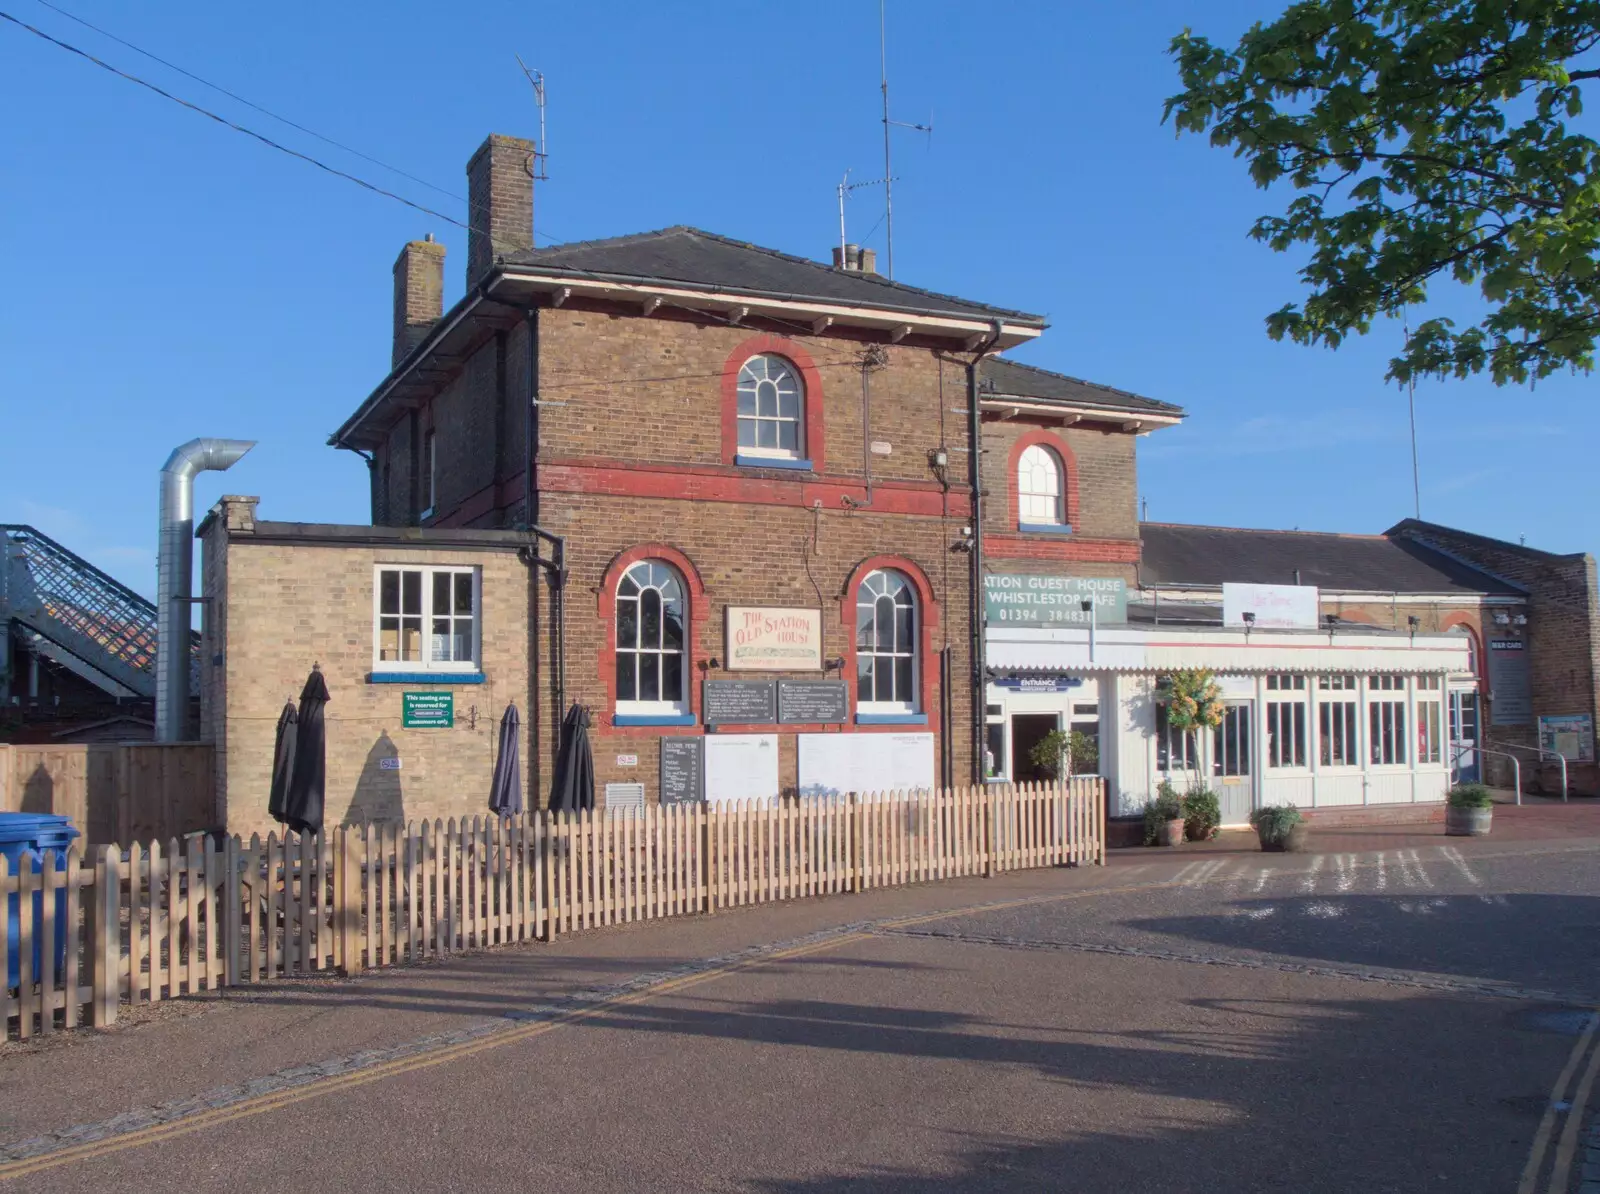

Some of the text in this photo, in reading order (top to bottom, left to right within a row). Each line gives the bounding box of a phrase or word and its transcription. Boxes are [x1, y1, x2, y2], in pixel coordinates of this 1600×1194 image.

[1028, 577, 1071, 590] GUEST
[1077, 579, 1121, 592] HOUSE
[988, 591, 1080, 605] WHISTLESTOP
[999, 608, 1037, 621] 01394
[1048, 610, 1091, 622] 384831
[764, 615, 810, 634] STATION
